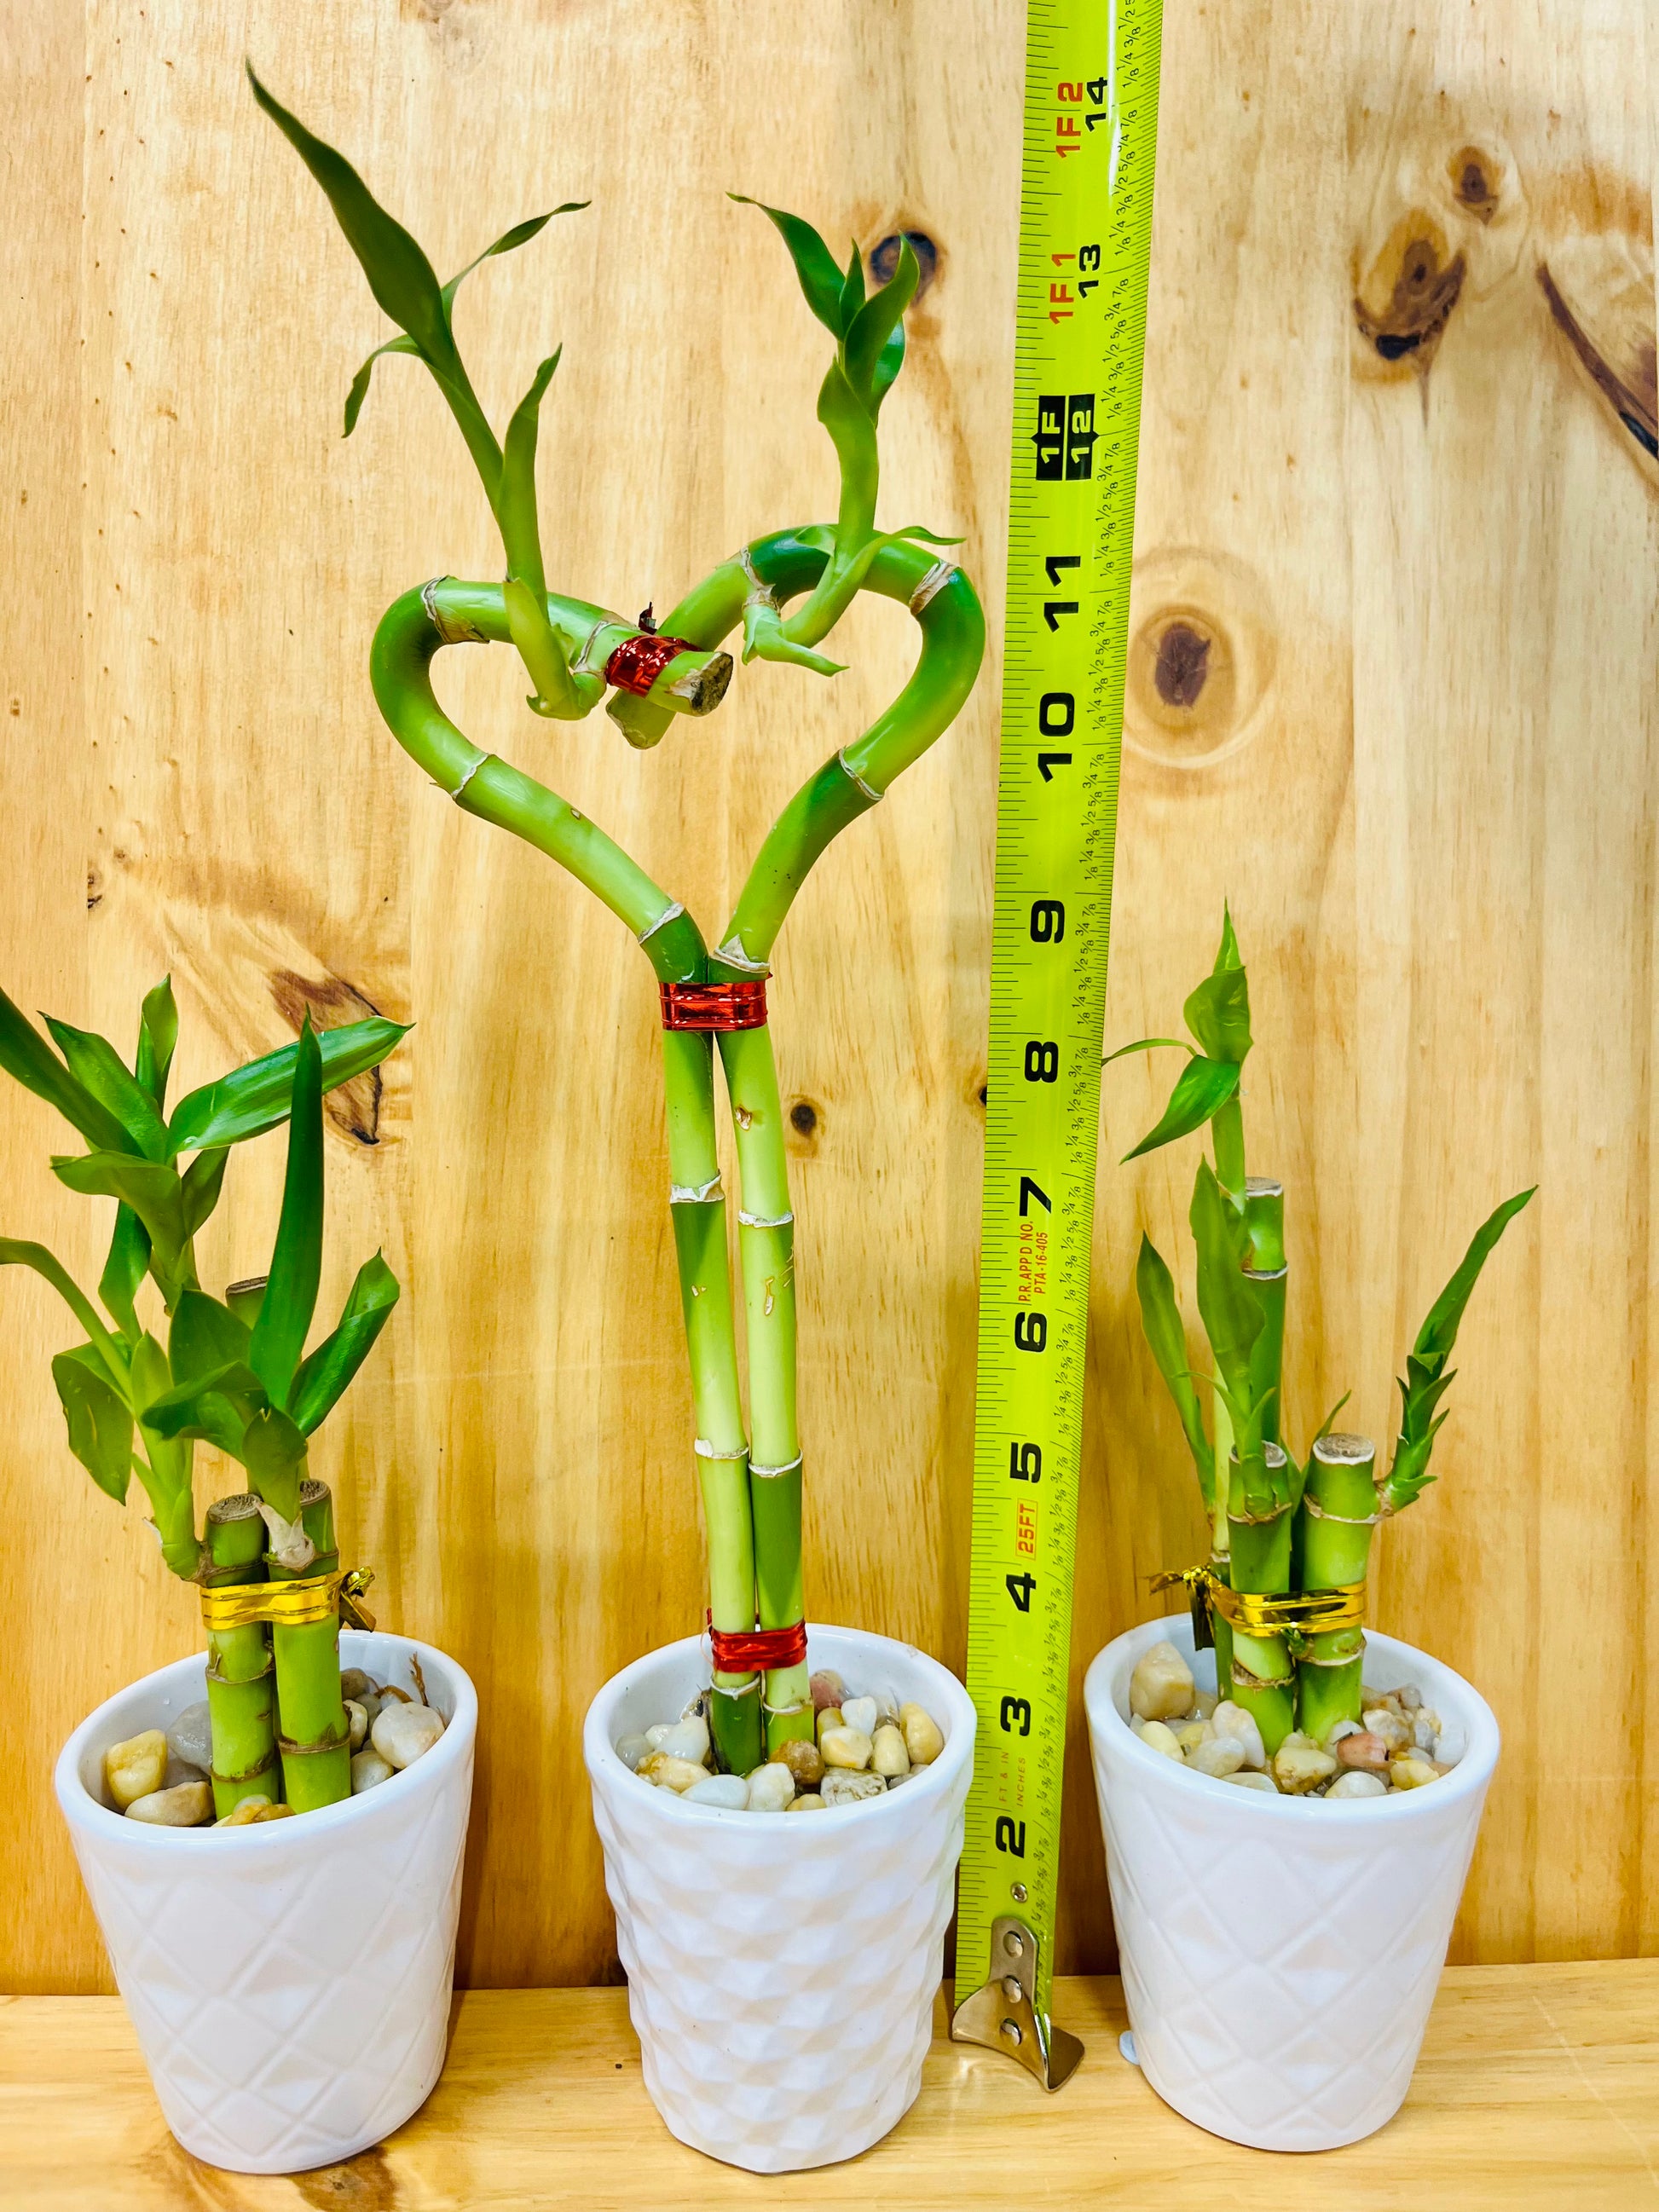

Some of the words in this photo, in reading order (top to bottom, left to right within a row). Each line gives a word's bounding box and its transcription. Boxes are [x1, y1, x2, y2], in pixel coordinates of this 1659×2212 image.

[1085, 77, 1107, 132] 14
[1078, 244, 1101, 298] 13
[1041, 412, 1061, 464] 1F
[1071, 410, 1091, 464] 12
[1043, 556, 1081, 632] 11
[1038, 692, 1075, 783] 10
[1030, 899, 1065, 944] 9
[1024, 1040, 1059, 1083] 8
[1019, 1176, 1052, 1217] 7
[1020, 1221, 1033, 1241] NO.
[1014, 1311, 1048, 1353] 6
[1009, 1441, 1042, 1483] 5
[1018, 1504, 1035, 1553] 25FT
[1006, 1572, 1037, 1613] 4
[1000, 1695, 1032, 1736] 3
[1016, 1758, 1026, 1807] INCHES
[996, 1816, 1026, 1858] 2
